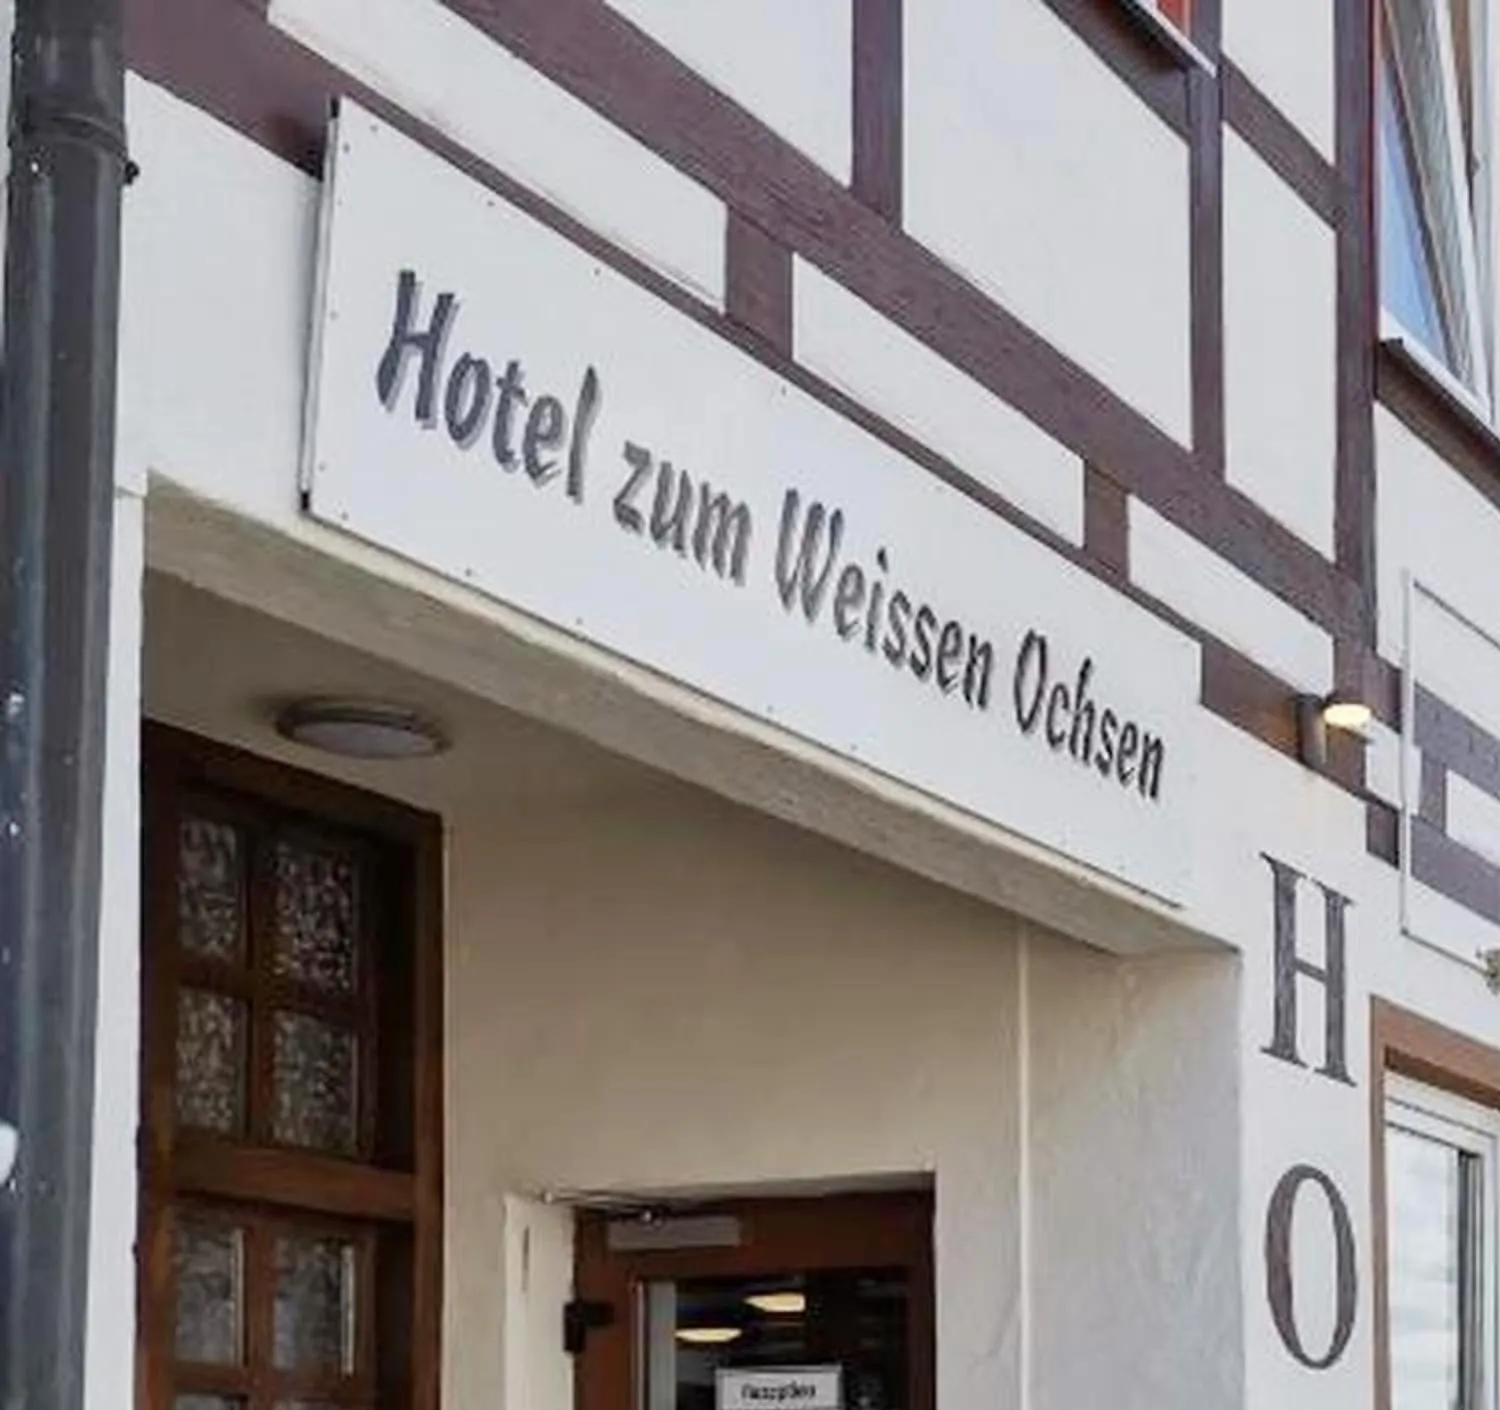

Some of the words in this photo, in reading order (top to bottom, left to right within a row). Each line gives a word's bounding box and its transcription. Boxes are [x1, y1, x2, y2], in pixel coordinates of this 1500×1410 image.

[376, 270, 600, 504] Hotel
[613, 440, 752, 587] zum
[773, 488, 994, 710] Weissen
[1012, 628, 1165, 801] Ochsen
